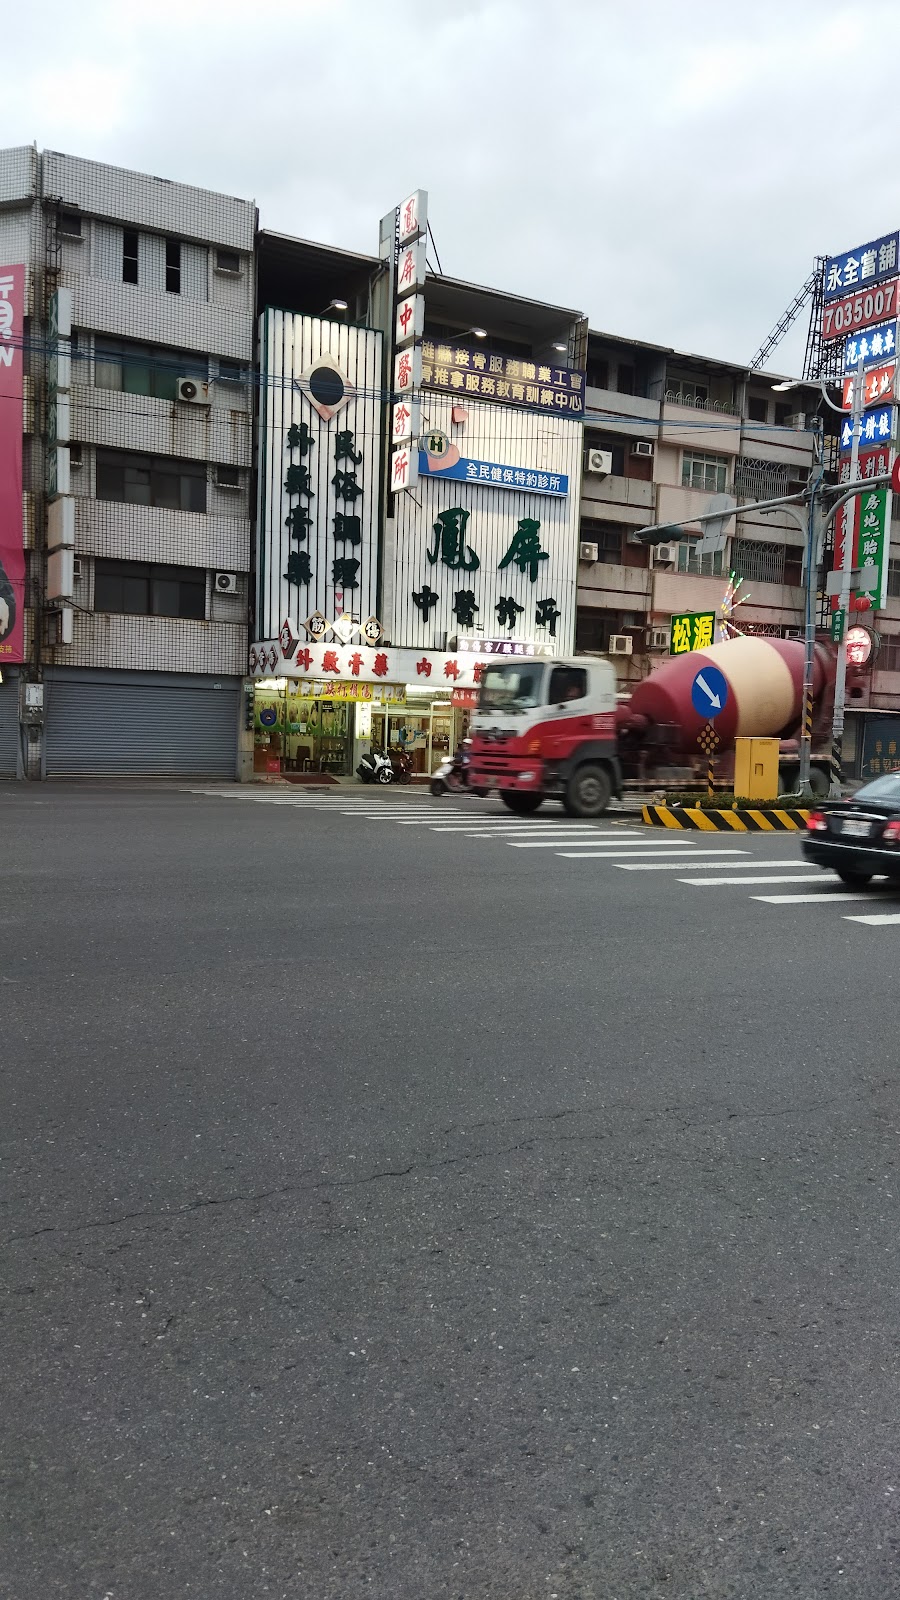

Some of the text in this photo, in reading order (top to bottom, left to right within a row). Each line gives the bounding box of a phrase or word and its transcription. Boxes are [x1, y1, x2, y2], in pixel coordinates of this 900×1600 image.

[827, 240, 896, 291] 永全當舖
[825, 285, 896, 334] 7035007
[393, 199, 418, 483] 鳳屏中醫診所
[420, 339, 583, 390] 雄縣接骨服務職業工會
[466, 462, 561, 491] 全民健保特約診所
[332, 430, 364, 588] 民俗調理
[427, 507, 550, 583] 鳳屏
[412, 585, 561, 637] 中醫診所
[672, 616, 714, 653] 松源
[295, 648, 389, 677] 外敷膏藥
